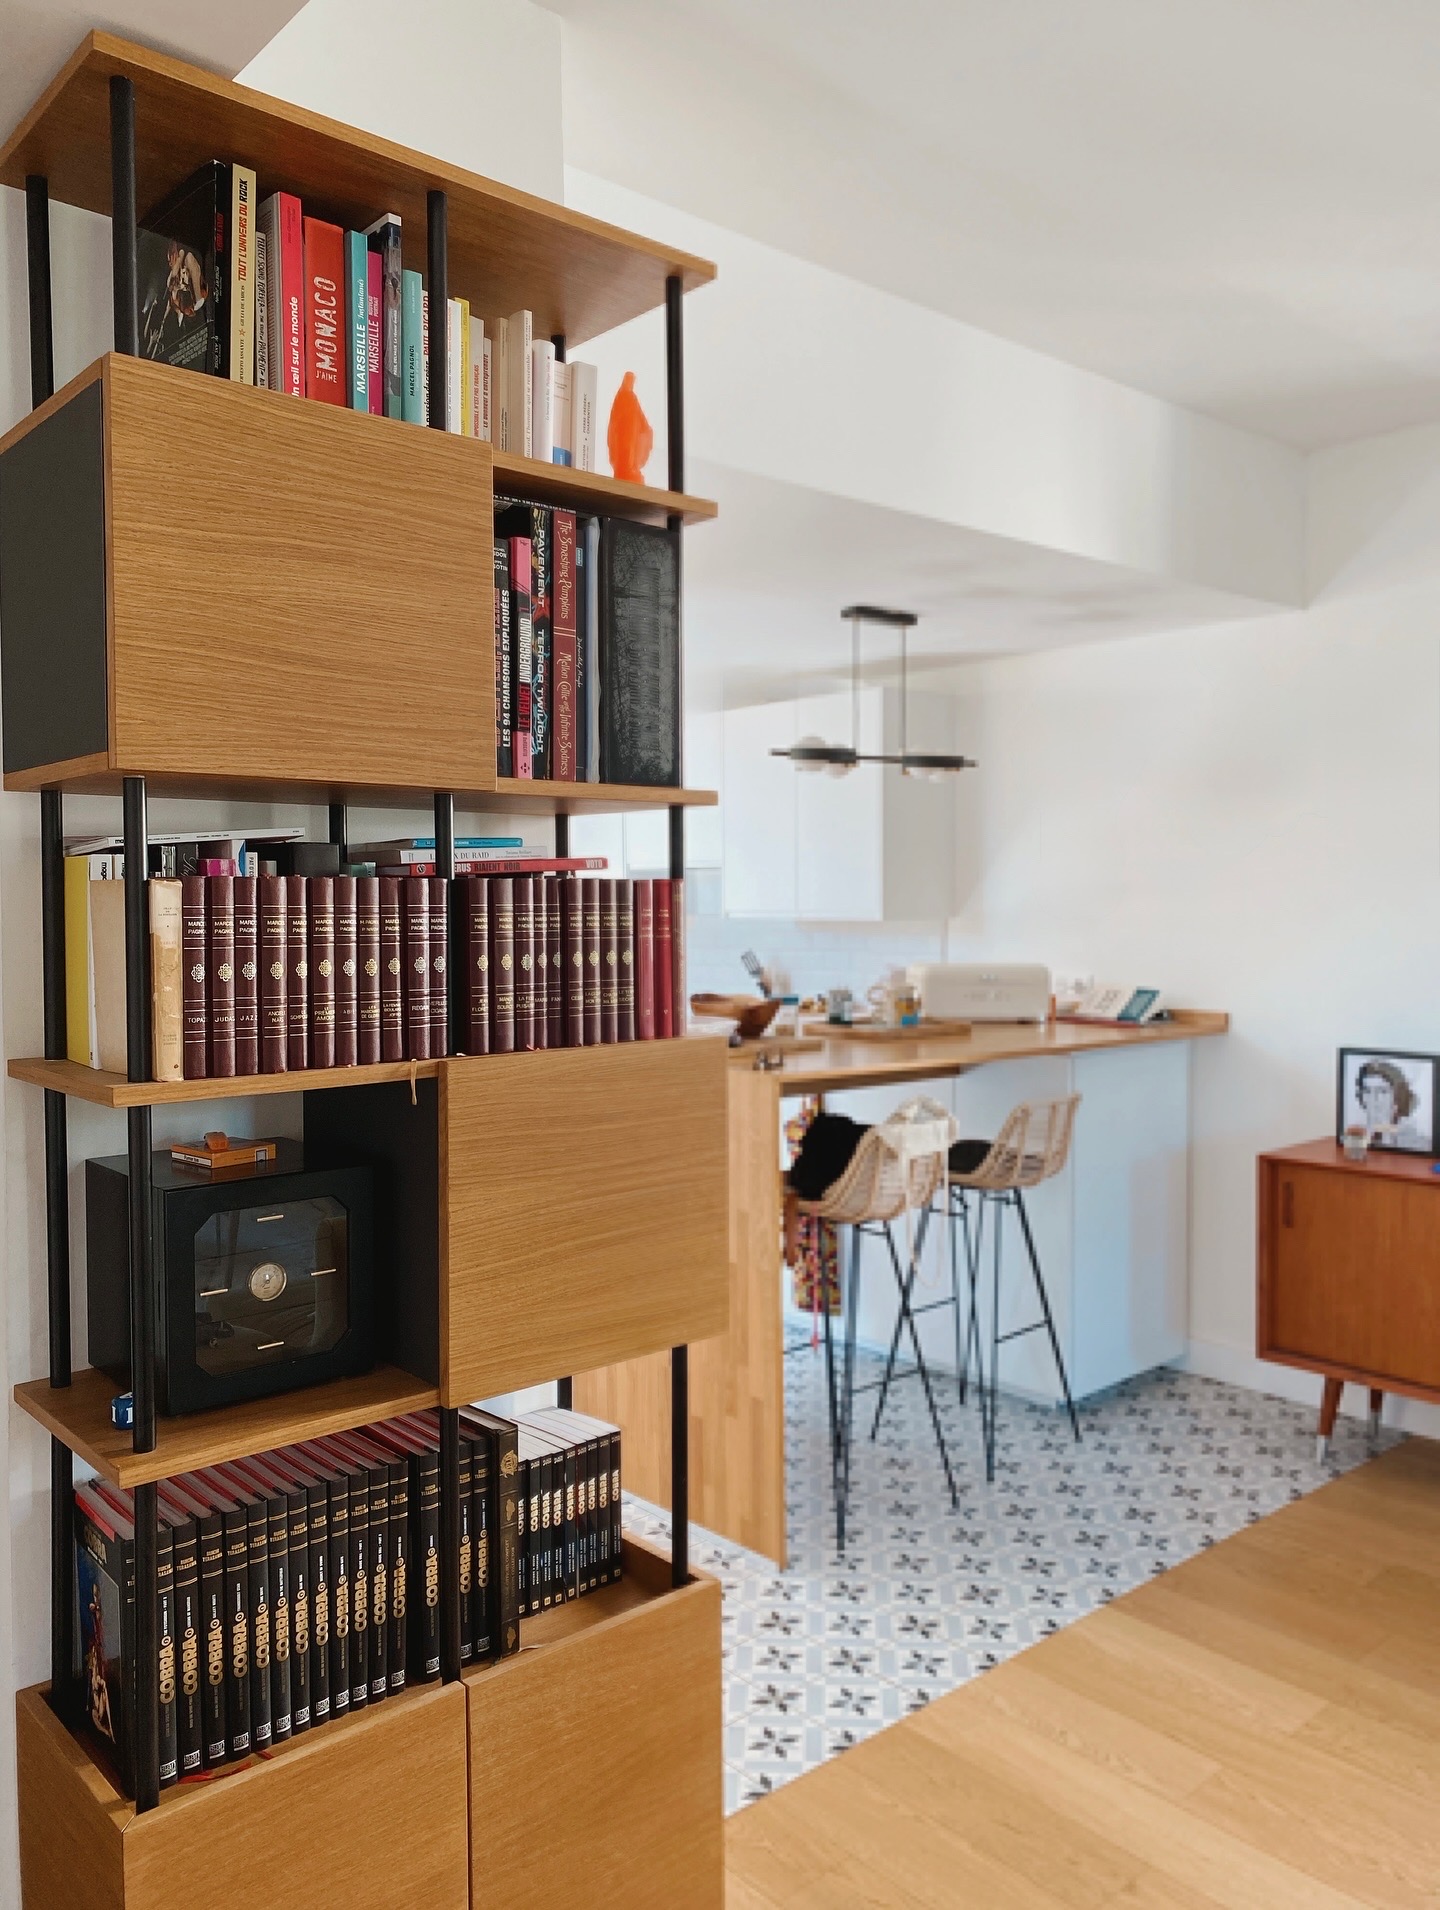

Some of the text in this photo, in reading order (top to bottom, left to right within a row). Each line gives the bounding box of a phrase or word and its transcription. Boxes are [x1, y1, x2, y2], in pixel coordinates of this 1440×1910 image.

[238, 178, 248, 281] TOUT L'UNIVERS DU ROCK
[257, 237, 265, 259] PERFECT
[257, 260, 265, 280] SOUND
[257, 281, 266, 308] FOREVER
[289, 297, 298, 335] monde
[290, 337, 299, 347] le
[314, 277, 337, 372] MONACO
[258, 341, 267, 372] PAVEMENT
[291, 347, 299, 365] sur
[357, 323, 366, 394] MARSEILLE
[368, 320, 379, 374] MARSEILLE
[315, 370, 337, 383] J'AIME
[557, 521, 573, 619] The Smashing Pumpkins
[501, 590, 511, 748] LES 94 CHANSONS EXPLIQUÉES
[519, 617, 531, 683] UNDERGROUND
[537, 628, 545, 684] TERROR
[557, 652, 572, 679] Mellon
[518, 684, 530, 716] VELVET
[557, 681, 572, 700] Collie
[537, 687, 545, 753] TWILIGHT
[560, 714, 571, 741] Infinite
[557, 737, 572, 776] Sadness
[460, 850, 490, 859] DU RAID
[474, 860, 501, 872] RIAIENT
[504, 861, 520, 871] NOIR
[585, 859, 603, 869] VOTO
[530, 1494, 539, 1532] COBRA
[542, 1491, 550, 1529] COBRA
[553, 1488, 561, 1526] COBRA
[599, 1472, 607, 1508] COBRA
[426, 1553, 438, 1607] COBRA
[459, 1541, 471, 1594] COBRA
[477, 1537, 489, 1588] COBRA
[315, 1588, 328, 1646] COBRA
[336, 1582, 349, 1639] COBRA
[354, 1576, 367, 1632] COBRA
[374, 1570, 386, 1626] COBRA
[393, 1564, 406, 1619] COBRA
[233, 1618, 247, 1678] COBRA
[256, 1611, 269, 1668] COBRA
[275, 1604, 289, 1661] COBRA
[295, 1596, 308, 1654] COBRA
[159, 1643, 174, 1704] COBRA
[183, 1635, 197, 1696] COBRA
[208, 1625, 223, 1686] COBRA
